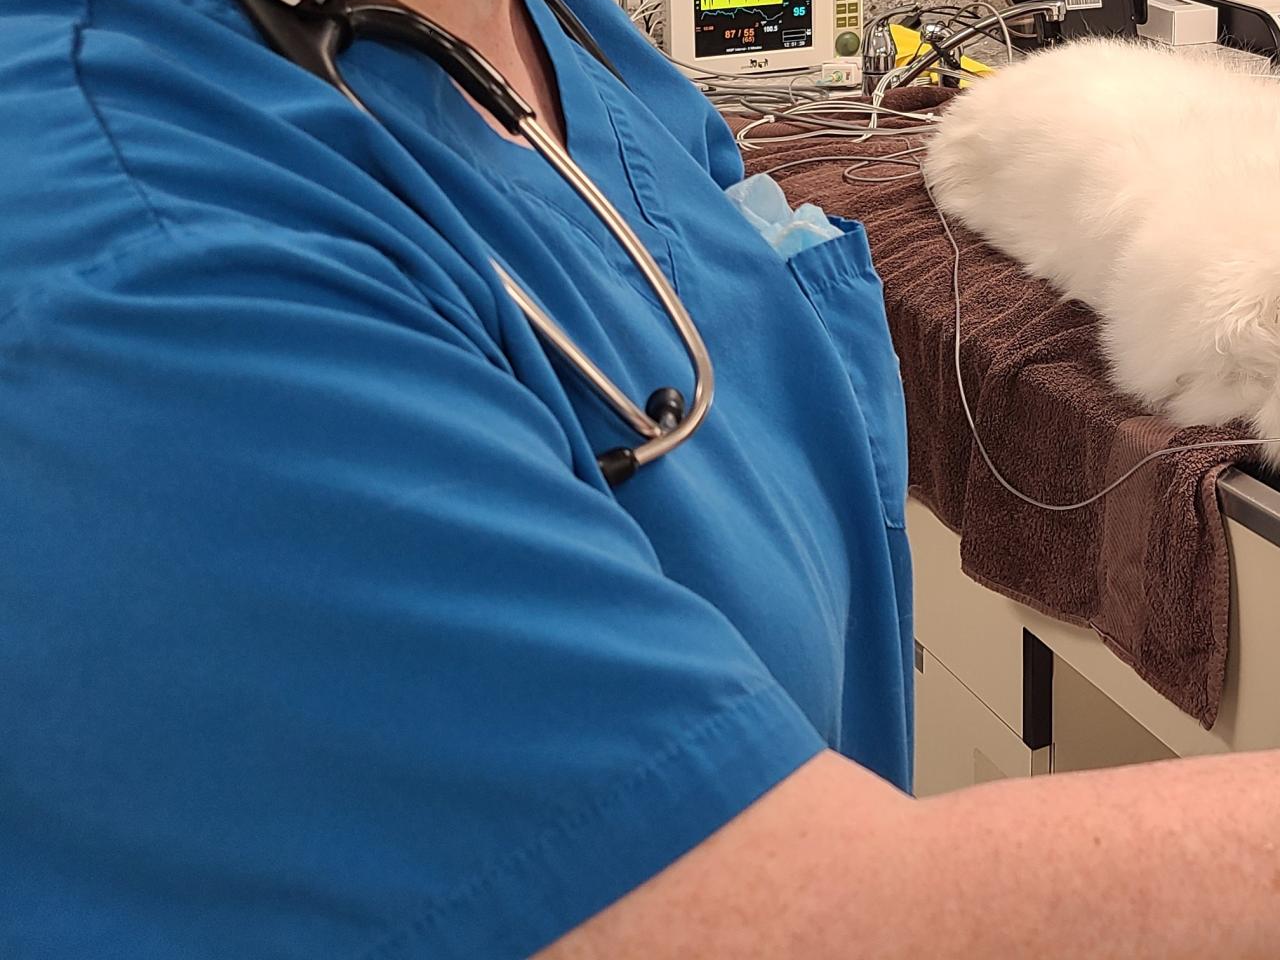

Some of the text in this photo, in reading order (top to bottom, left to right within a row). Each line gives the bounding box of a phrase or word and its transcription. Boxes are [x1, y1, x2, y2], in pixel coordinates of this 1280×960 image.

[793, 6, 806, 16] 95
[725, 30, 737, 39] 87
[743, 28, 755, 37] 55
